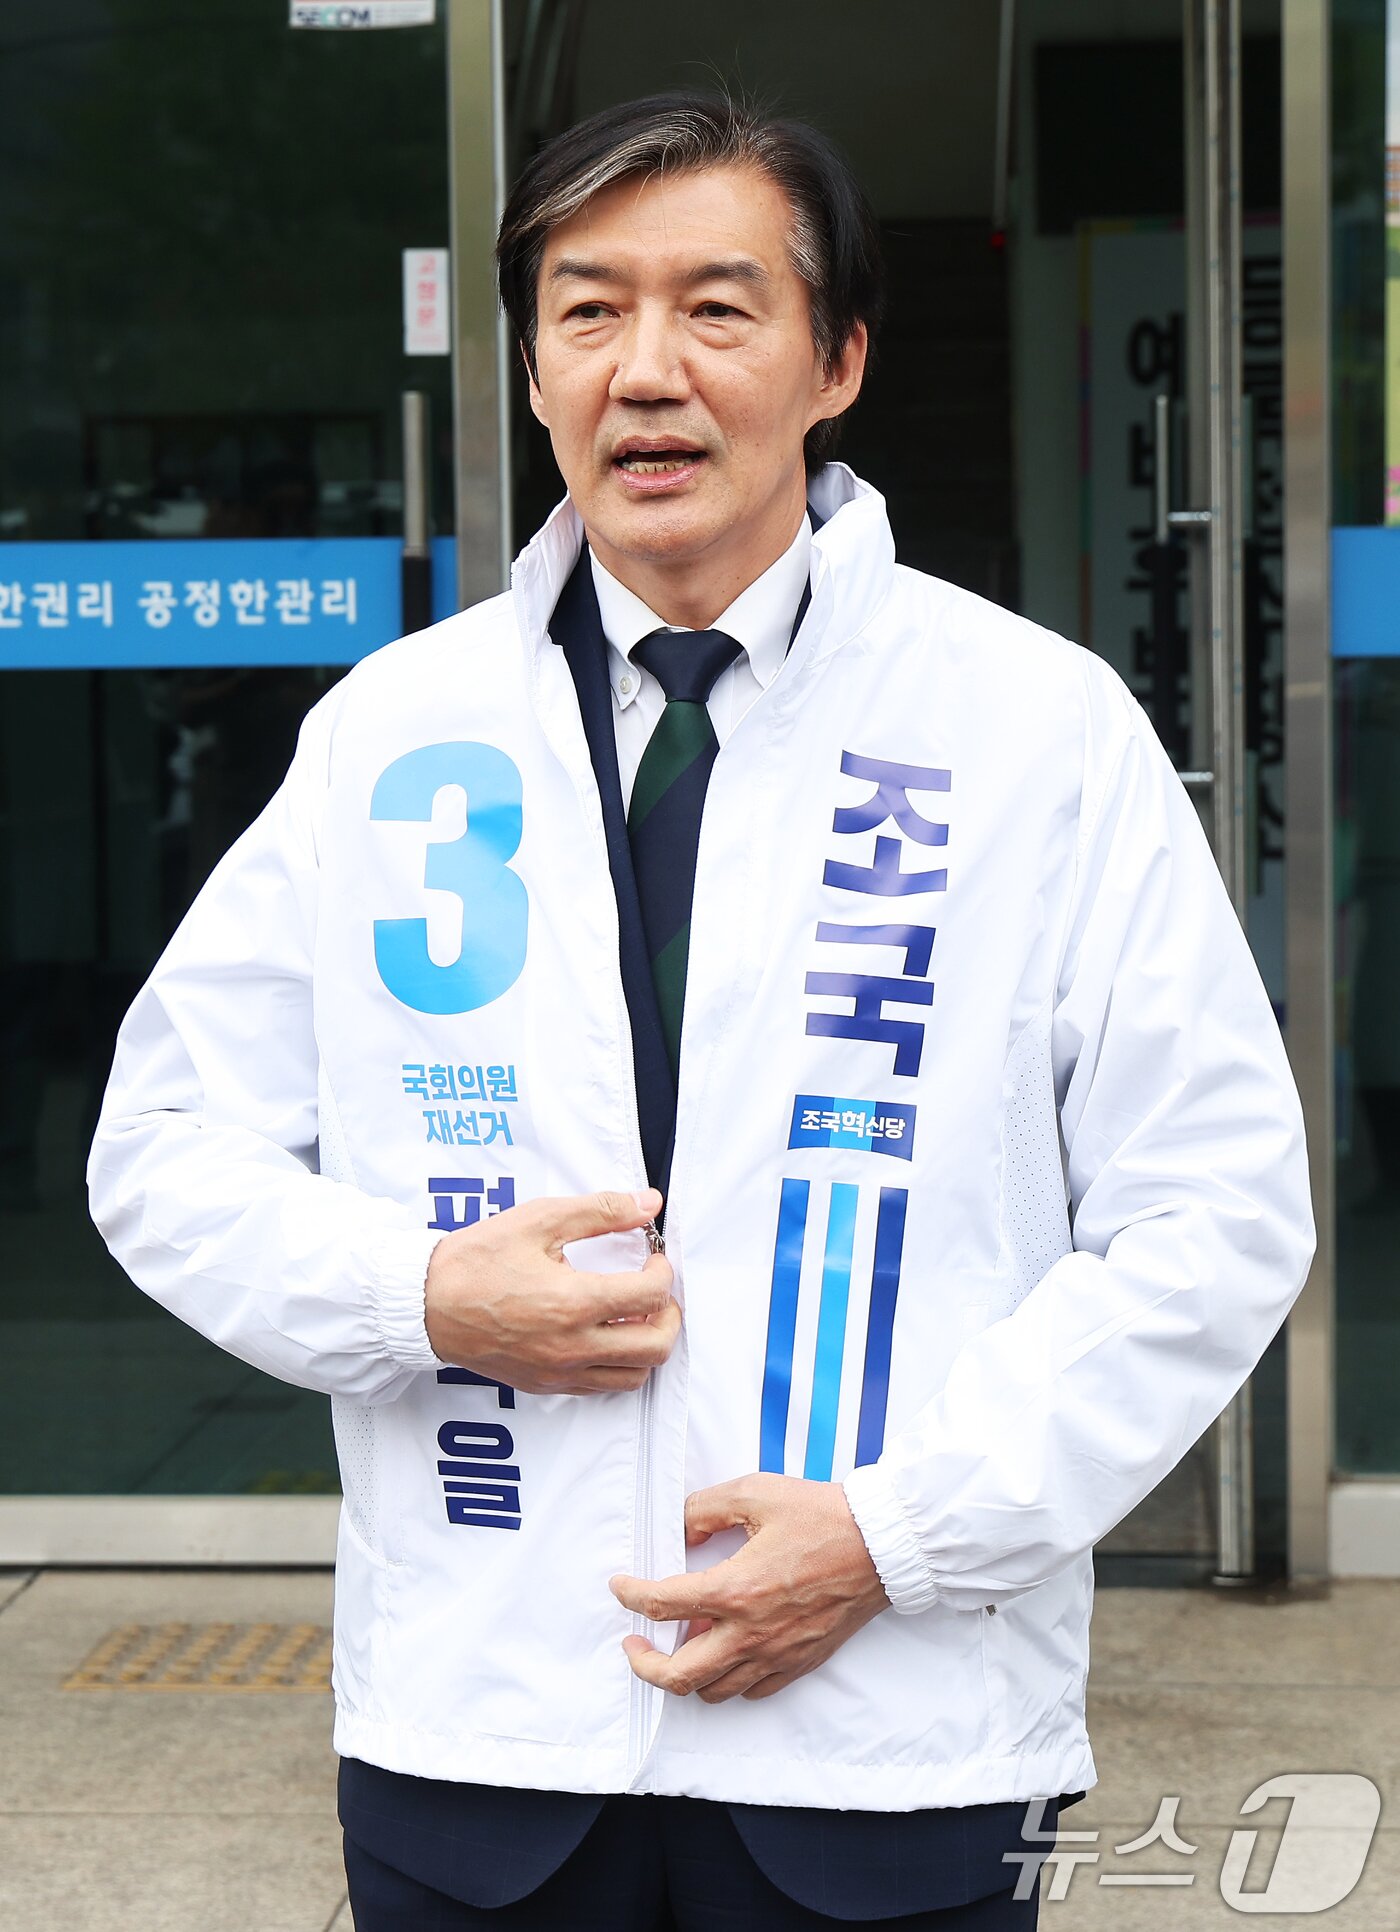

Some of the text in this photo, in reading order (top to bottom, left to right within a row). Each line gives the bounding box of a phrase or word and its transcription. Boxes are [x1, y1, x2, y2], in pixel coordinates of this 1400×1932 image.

[138, 578, 357, 629] 공정한관리
[370, 740, 529, 1015] 3
[805, 749, 952, 1078] 조국
[402, 1063, 518, 1102] 국회의원
[422, 1109, 514, 1146] 재선거
[800, 1110, 906, 1139] 조국혁신당
